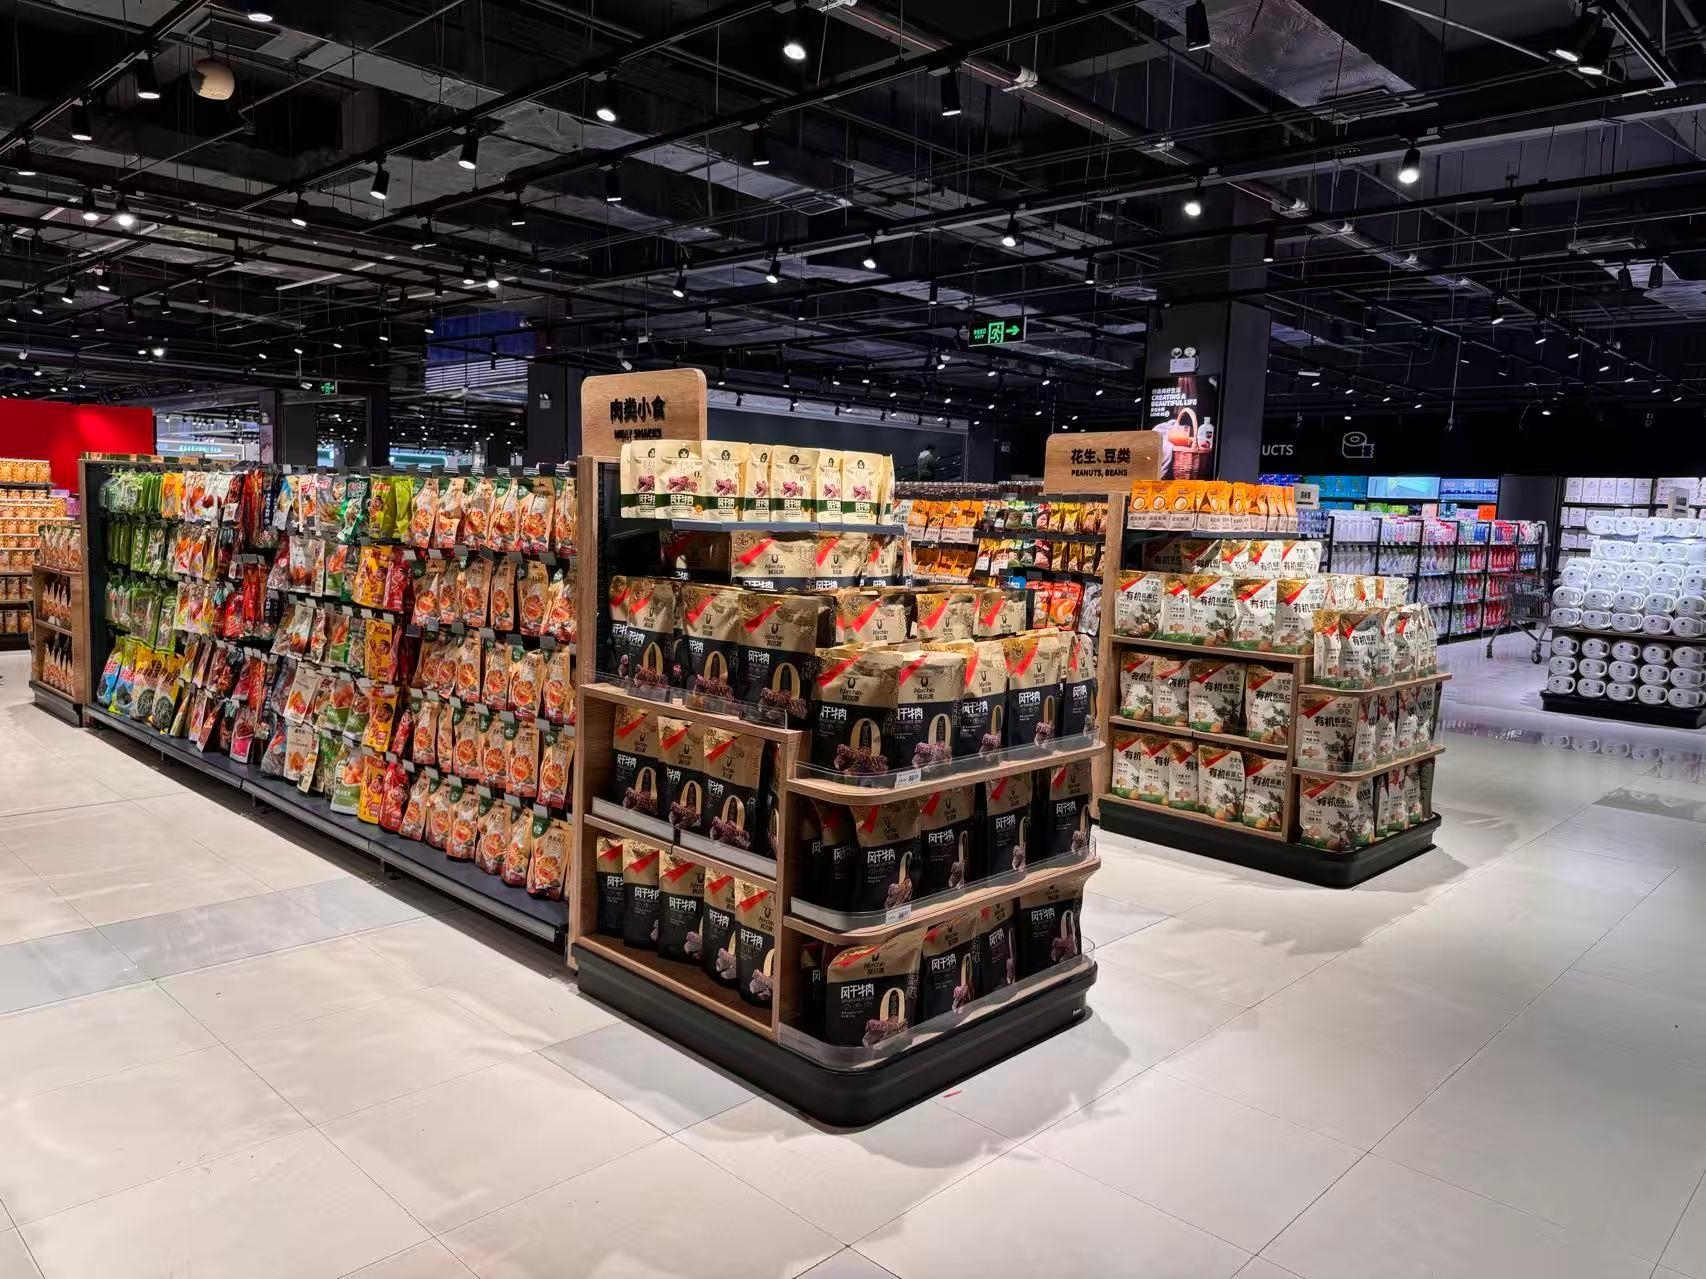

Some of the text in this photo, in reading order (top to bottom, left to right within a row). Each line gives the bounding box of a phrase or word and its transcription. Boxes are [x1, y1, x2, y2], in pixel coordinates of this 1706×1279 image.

[610, 395, 665, 424] 肉类小食
[1150, 398, 1198, 407] BEAUTIFUL LIFE
[1071, 447, 1131, 465] 花生、豆类
[1071, 469, 1128, 478] PEANUTS, BEANS
[841, 983, 874, 999] 风干牛肉
